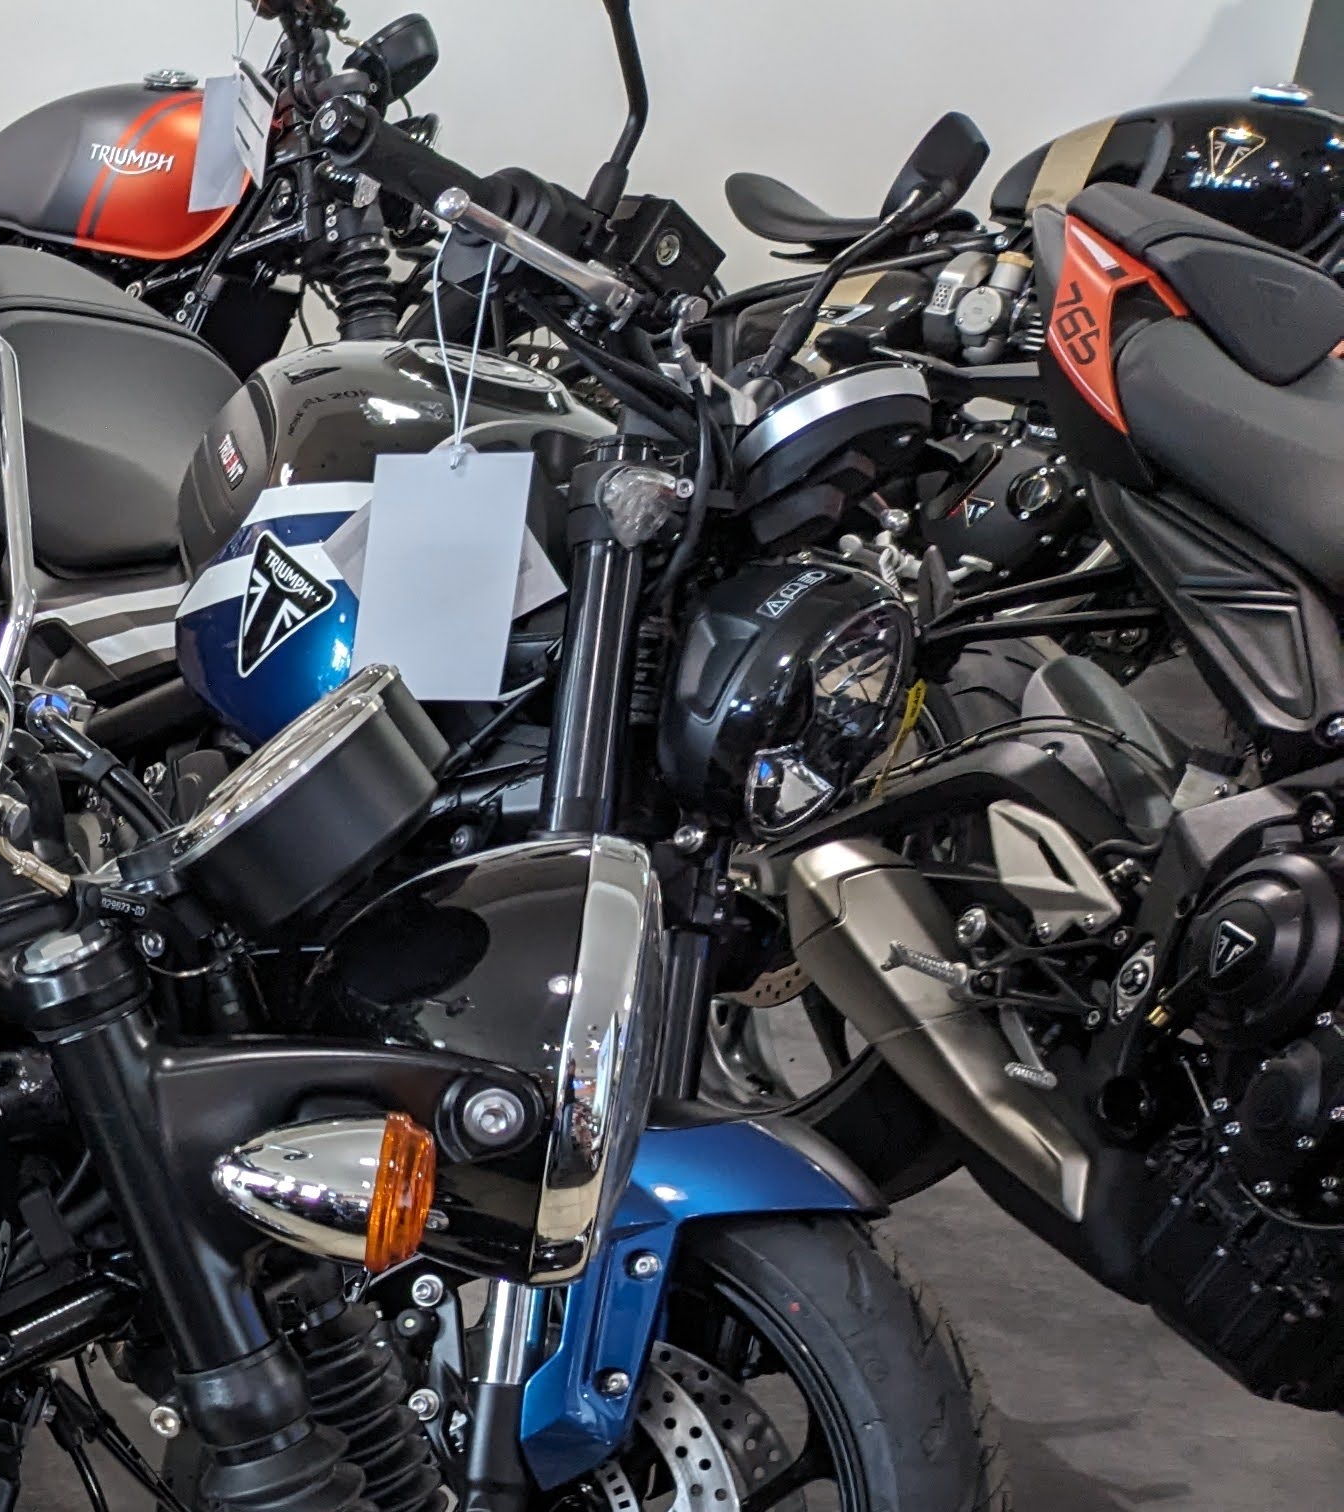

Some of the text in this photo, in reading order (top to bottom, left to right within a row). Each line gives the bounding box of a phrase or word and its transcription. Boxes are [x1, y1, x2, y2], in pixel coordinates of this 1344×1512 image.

[90, 142, 175, 175] TRIUMPH
[1056, 281, 1100, 365] 765
[264, 549, 314, 599] TRIUMPH
